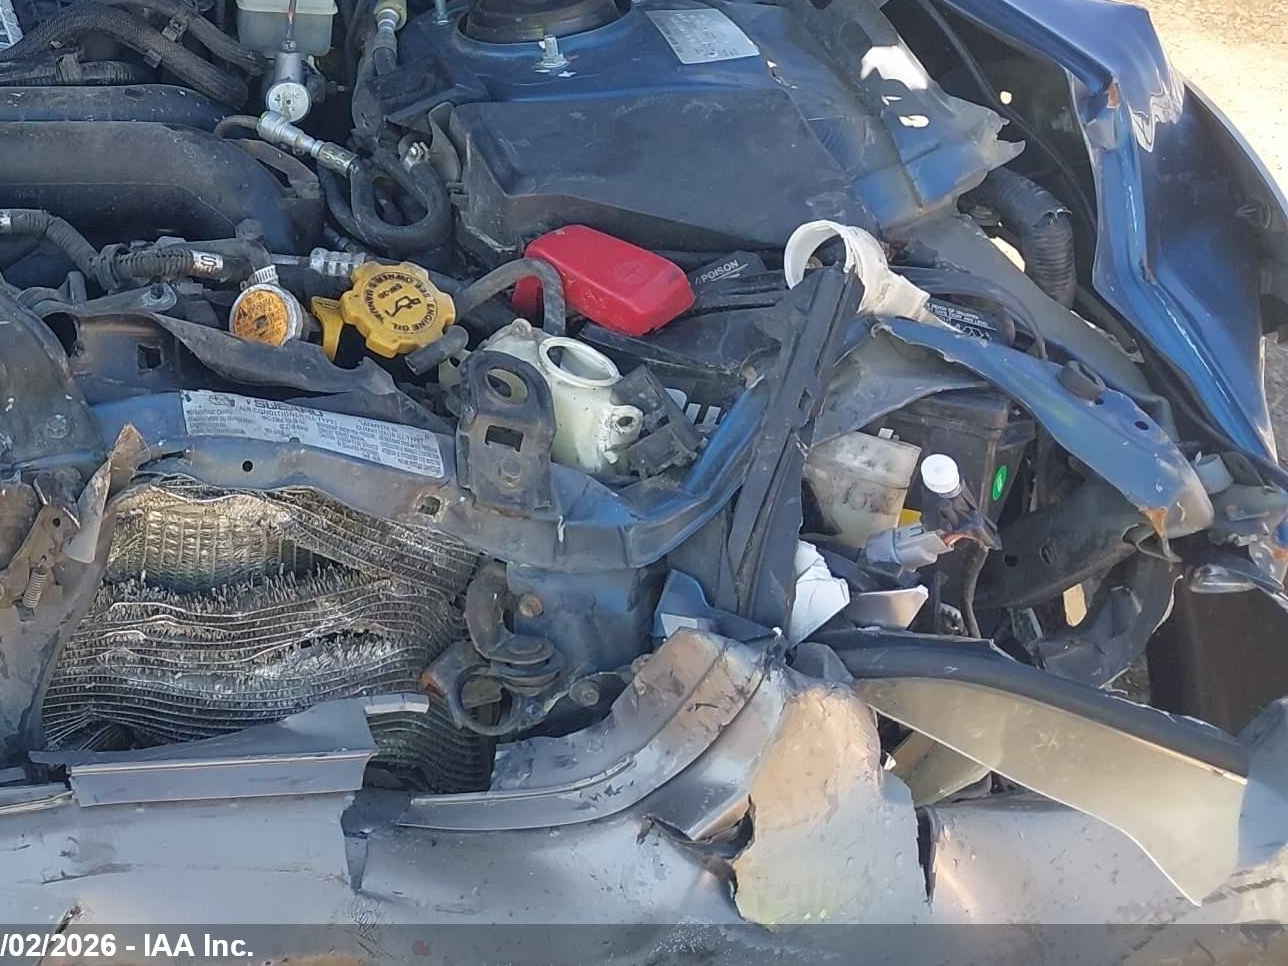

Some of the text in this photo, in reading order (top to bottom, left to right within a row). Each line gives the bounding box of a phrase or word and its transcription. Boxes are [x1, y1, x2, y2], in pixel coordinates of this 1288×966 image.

[700, 259, 739, 283] POISON
[392, 303, 435, 332] ENGINE OIL
